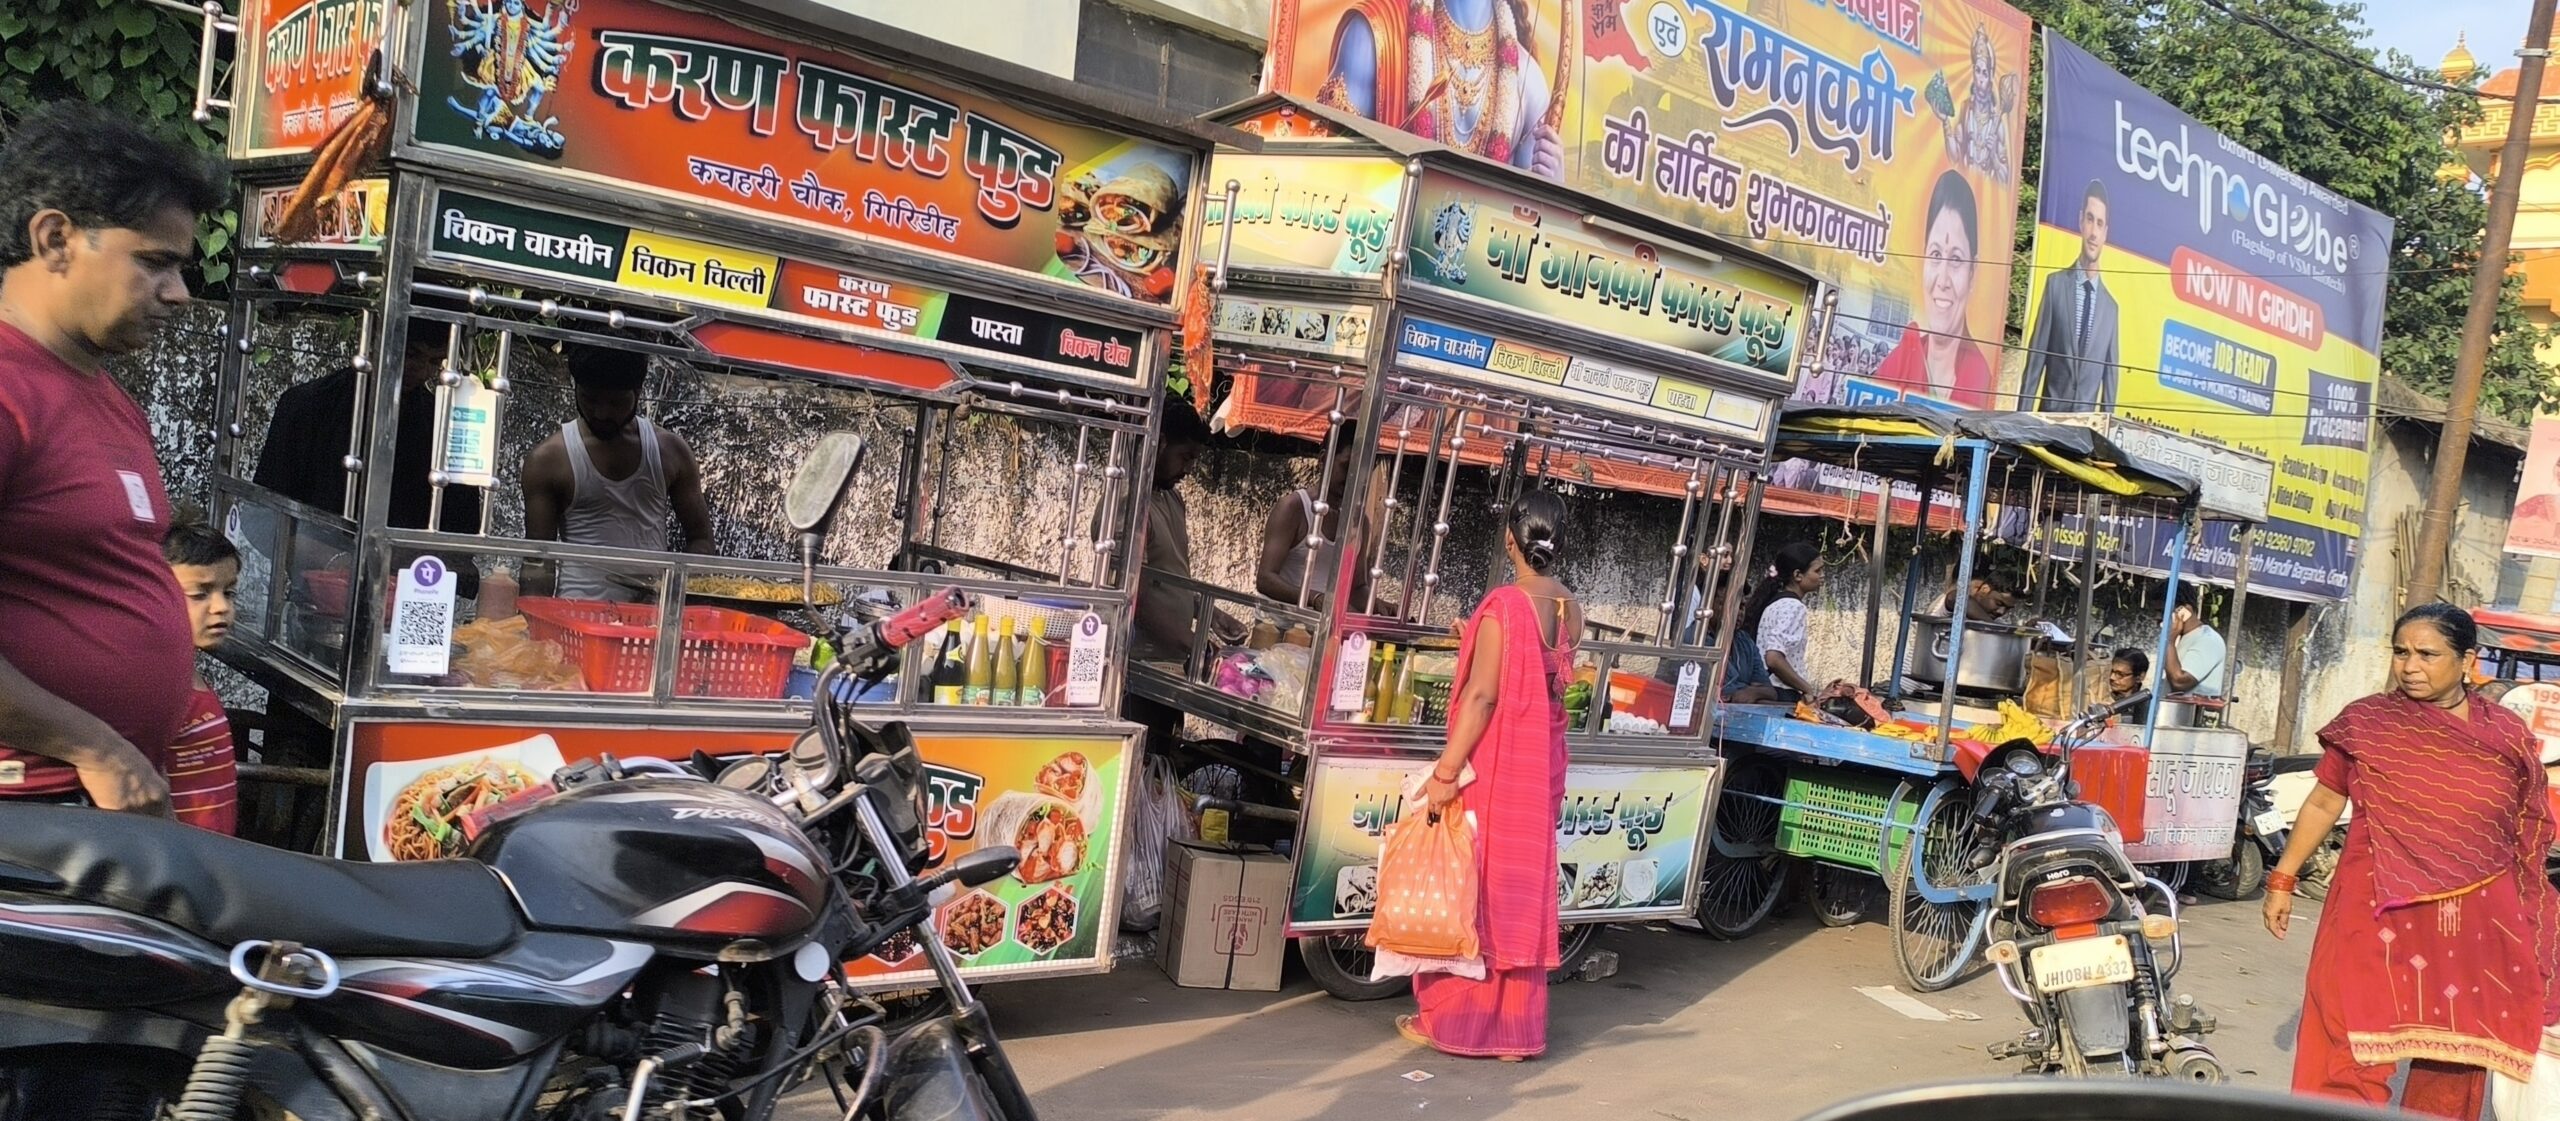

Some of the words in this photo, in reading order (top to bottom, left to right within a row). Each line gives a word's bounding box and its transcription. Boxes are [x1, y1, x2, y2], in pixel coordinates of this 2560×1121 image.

[1653, 15, 1680, 47] एवं
[601, 30, 788, 136] करण
[797, 60, 959, 177] फास्ट
[1700, 5, 1902, 172] रामनवमी
[1603, 107, 1650, 187] की
[1653, 130, 1743, 212] हार्दिक
[688, 156, 781, 200] कचहरी
[864, 188, 960, 242] गिरिडीह
[443, 208, 516, 251] चिकन
[524, 231, 614, 269] चाउमीन
[631, 245, 696, 283] चिकन
[703, 258, 767, 295] चिल्ली
[2277, 250, 2287, 266] of
[803, 286, 872, 318] फास्ट
[838, 273, 892, 299] करण
[1540, 232, 1661, 314] जानकी
[1660, 267, 1741, 336] फास्ट
[2186, 258, 2234, 308] NOW
[2236, 280, 2255, 318] IN
[2258, 290, 2315, 341] GIRIDIH
[970, 315, 1024, 346] पास्ता
[1059, 328, 1102, 364] चिकन
[1403, 324, 1440, 351] चिकन
[1443, 336, 1487, 362] चाउमीन
[1493, 343, 1529, 372] चिकन
[2164, 334, 2213, 368] BECOME
[2212, 340, 2234, 375] JOB
[2234, 348, 2271, 386] READY
[2327, 382, 2358, 414] 100%
[2308, 407, 2368, 442] Placement
[2047, 869, 2070, 880] Hero
[2043, 966, 2092, 988] JH10BH
